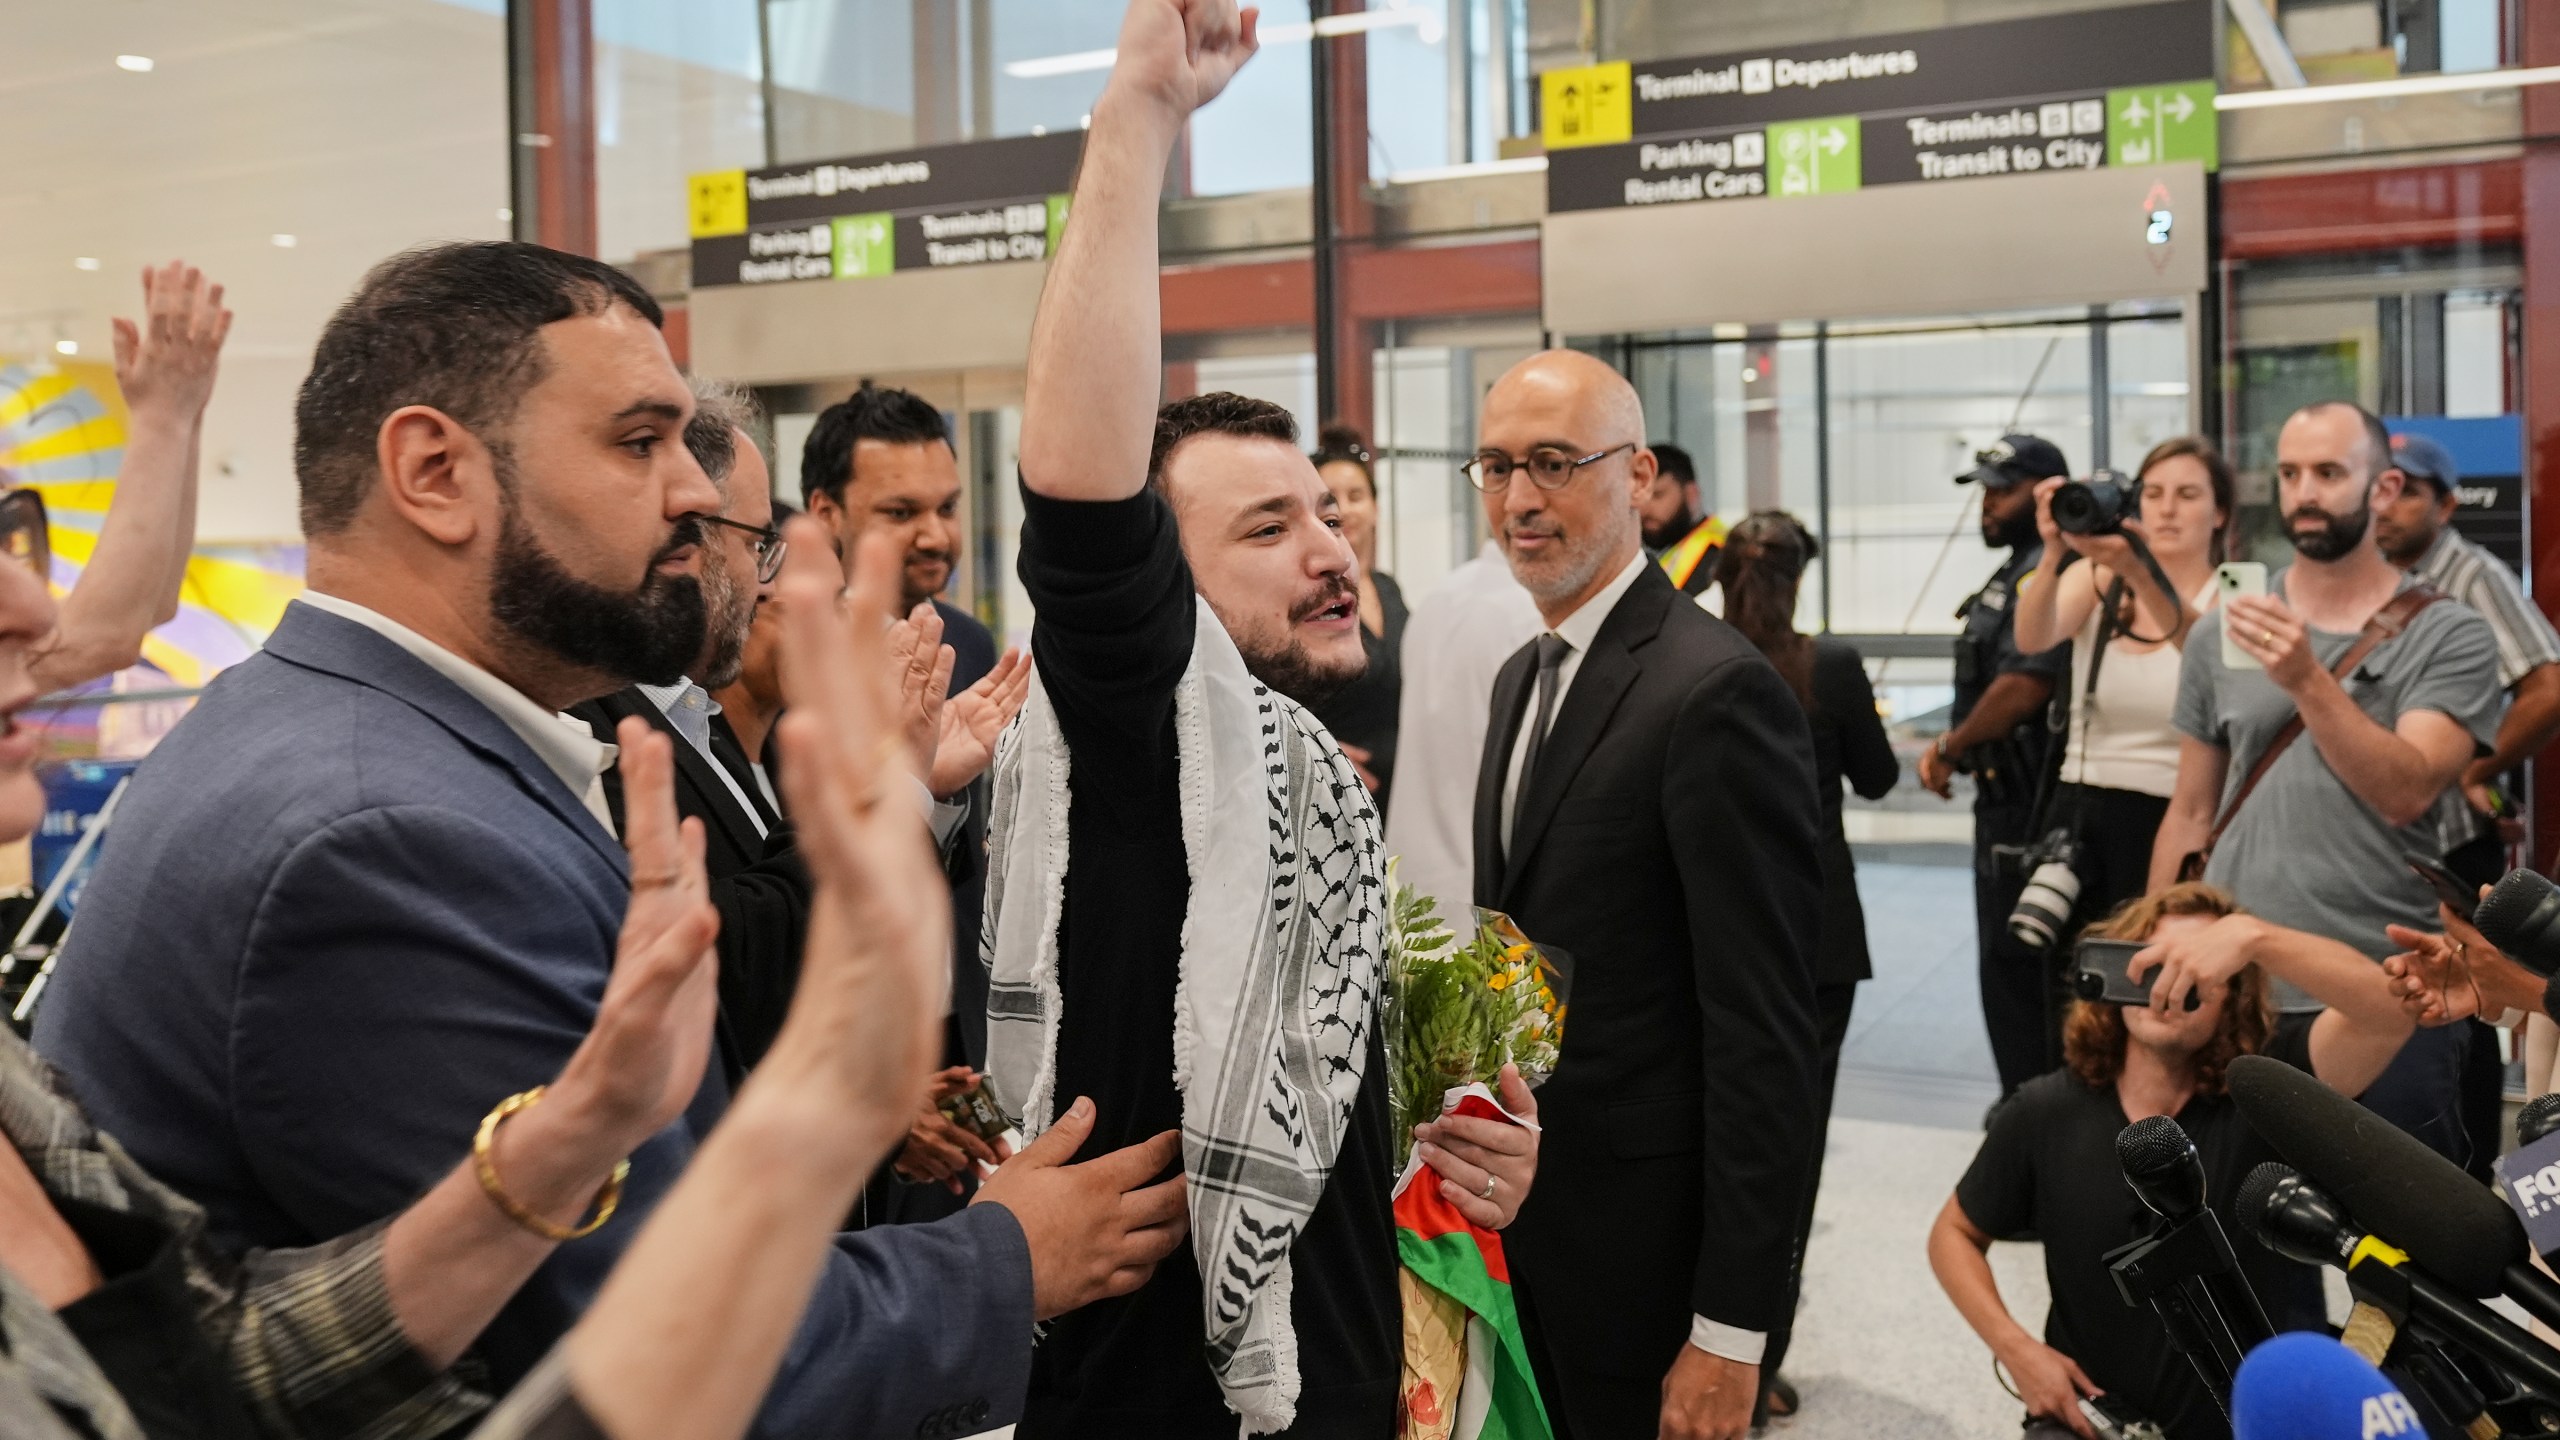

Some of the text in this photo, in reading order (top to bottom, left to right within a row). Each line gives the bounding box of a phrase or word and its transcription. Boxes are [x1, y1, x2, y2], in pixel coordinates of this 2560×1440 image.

[1636, 66, 1739, 100] Terminal
[1775, 50, 1917, 88] Departures
[1906, 108, 2038, 145] Terminals
[1640, 139, 1732, 171] Parking
[1916, 138, 2103, 179] Transit to City
[836, 161, 930, 192] Departures
[1625, 170, 1764, 204] Rental Cars
[2147, 210, 2172, 244] 2
[2512, 1160, 2560, 1208] FO
